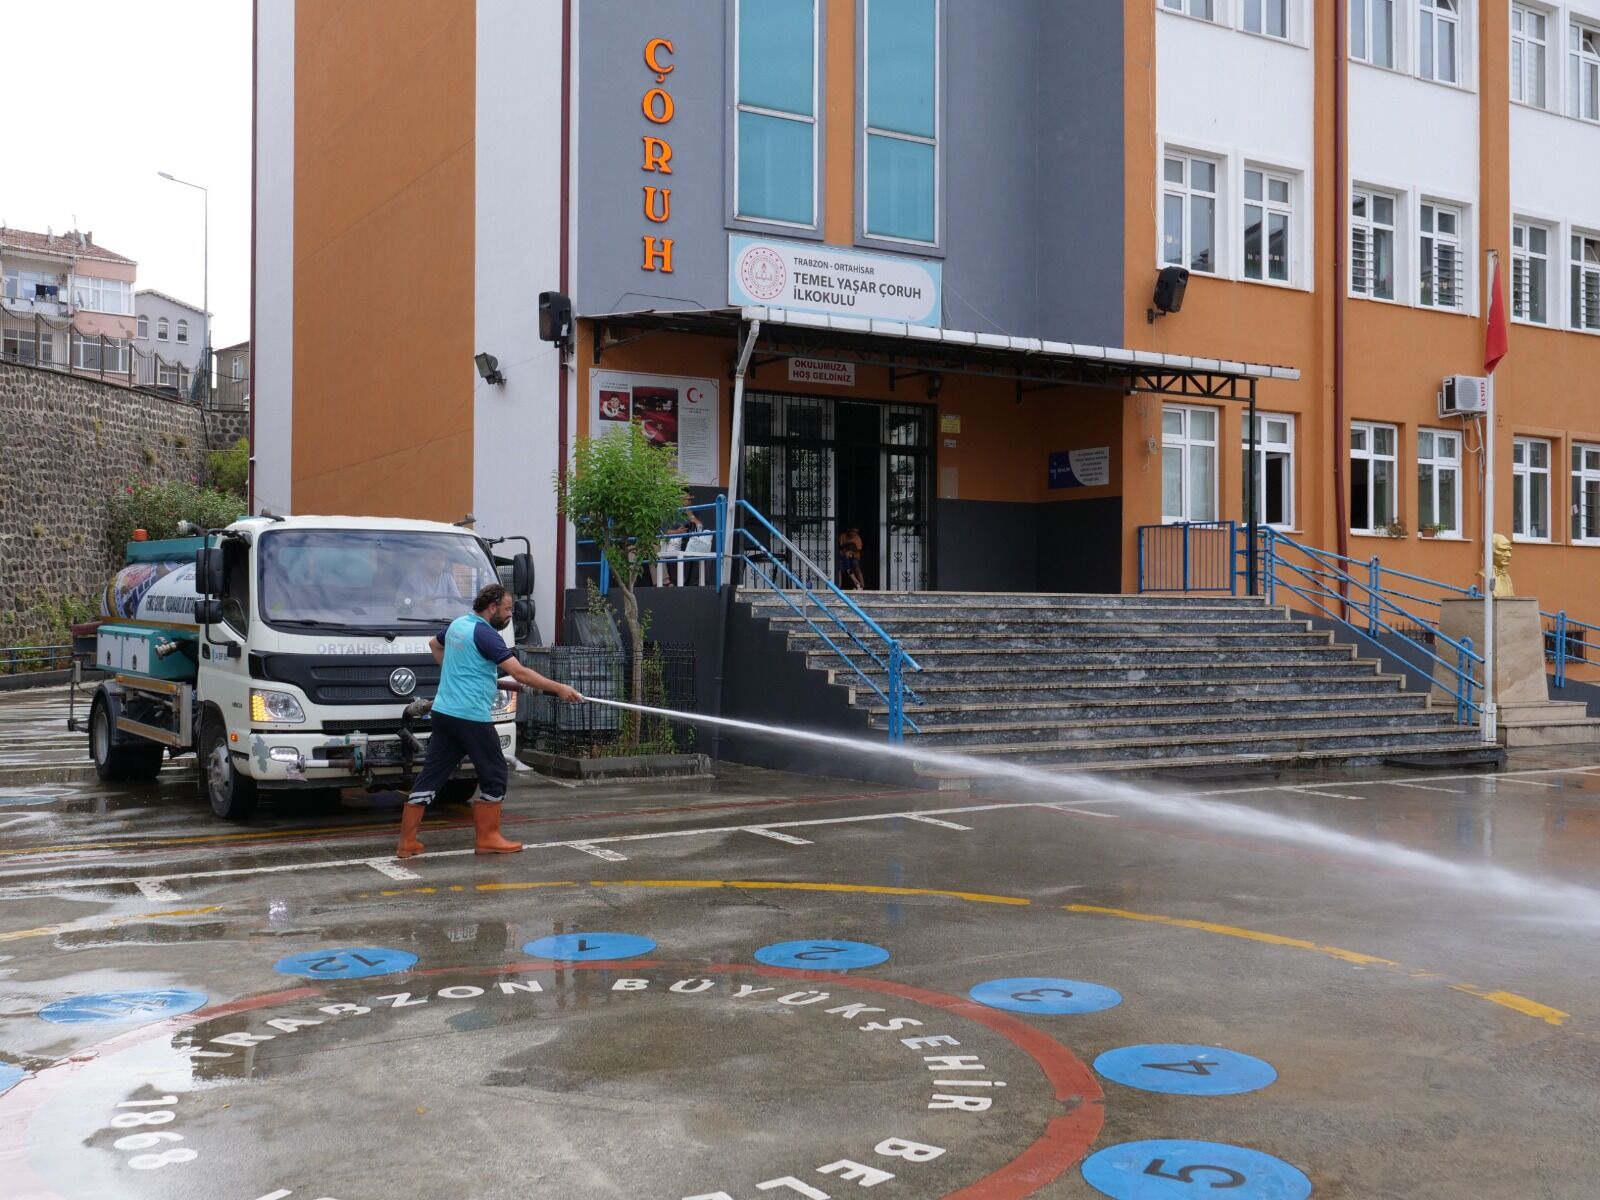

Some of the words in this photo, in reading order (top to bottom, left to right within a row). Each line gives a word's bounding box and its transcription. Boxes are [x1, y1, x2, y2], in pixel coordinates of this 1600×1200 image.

[641, 37, 674, 273] ÇORUH
[793, 256, 829, 270] TRABZON
[834, 262, 875, 276] ORTAHİSAR
[793, 272, 835, 289] TEMEL
[837, 277, 876, 294] YAŞAR
[878, 283, 922, 301] ÇORUH
[793, 284, 856, 307] İLKOKULU
[794, 359, 847, 372] OKULUMUZA
[792, 370, 811, 380] HOŞ
[812, 371, 852, 383] GELDİNİZ
[297, 953, 387, 973] 12
[794, 945, 849, 962] 2
[1010, 987, 1074, 1003] 3
[611, 977, 1007, 1113] BÜYÜKŞEHİR
[1140, 1058, 1220, 1077] 4
[109, 1094, 199, 1171] 1868
[682, 1136, 947, 1200] BEL
[1142, 1157, 1247, 1190] 5
